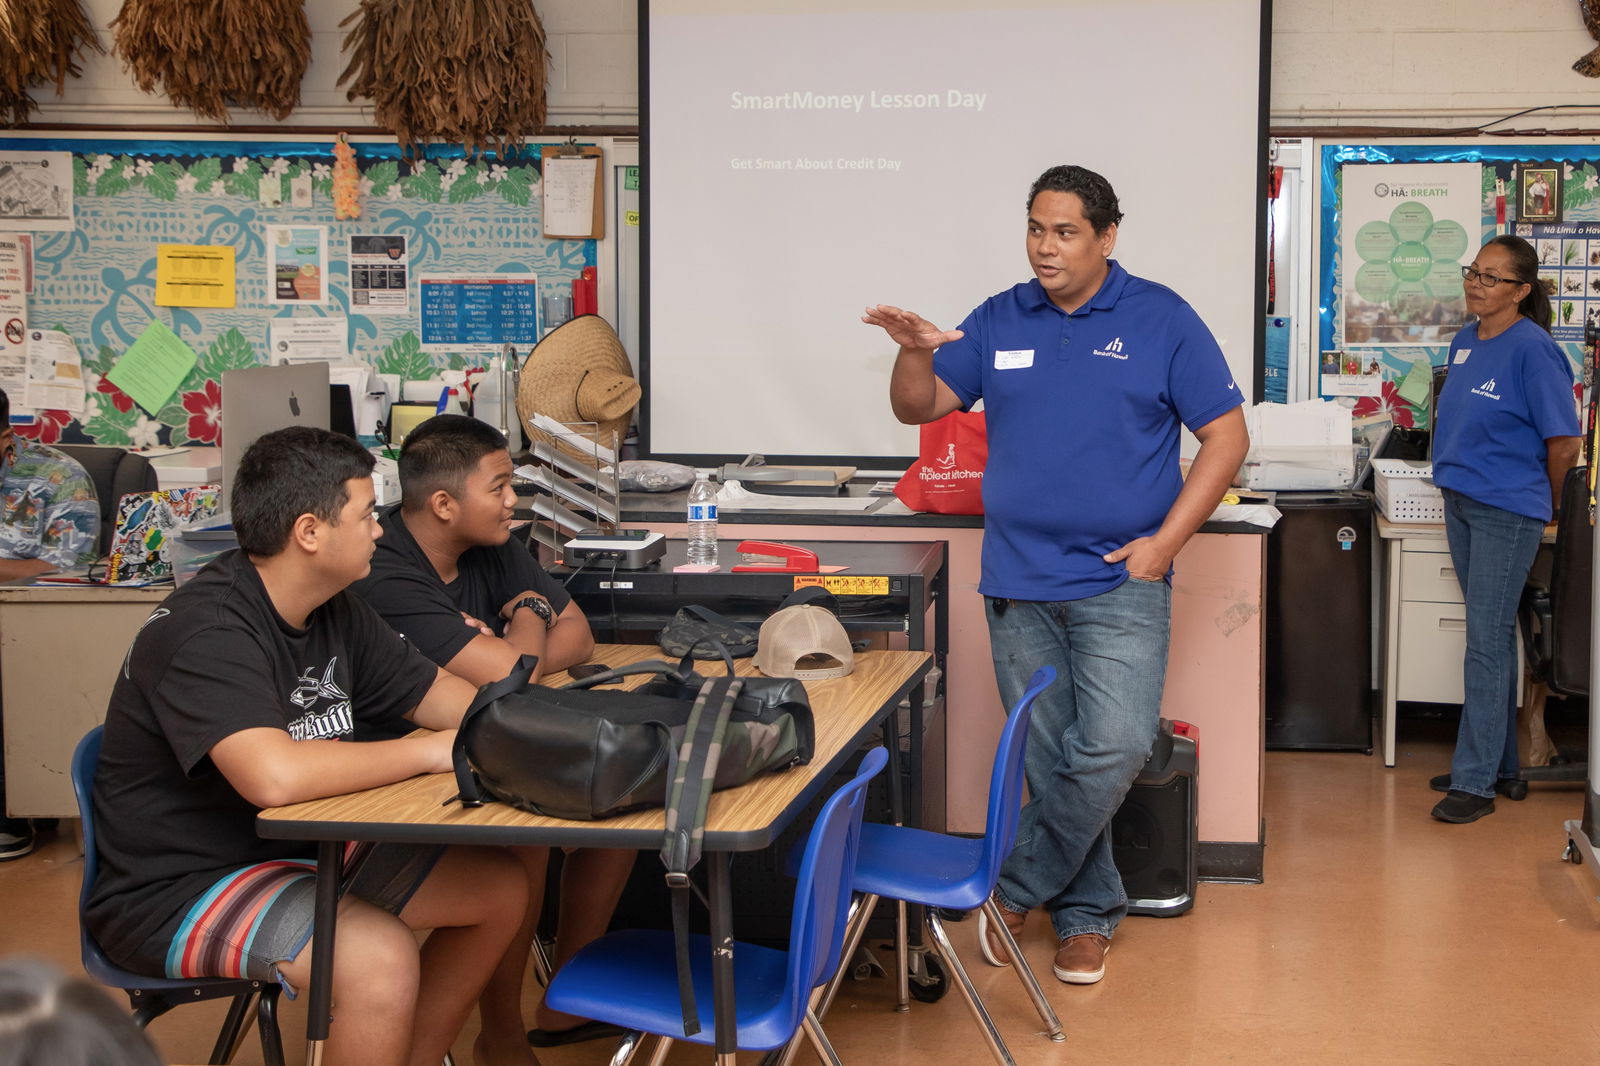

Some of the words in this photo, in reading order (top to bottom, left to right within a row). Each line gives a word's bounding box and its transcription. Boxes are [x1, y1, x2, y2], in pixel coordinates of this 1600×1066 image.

[730, 90, 864, 113] SmartMoney
[870, 90, 940, 109] Lesson
[947, 89, 987, 112] Day
[730, 157, 752, 170] Get
[755, 157, 792, 170] Smart
[795, 157, 833, 170] About
[836, 157, 874, 170] Credit
[877, 157, 902, 171] Day
[629, 169, 640, 177] LE
[1410, 188, 1448, 197] BREATH
[952, 470, 984, 480] kitchen
